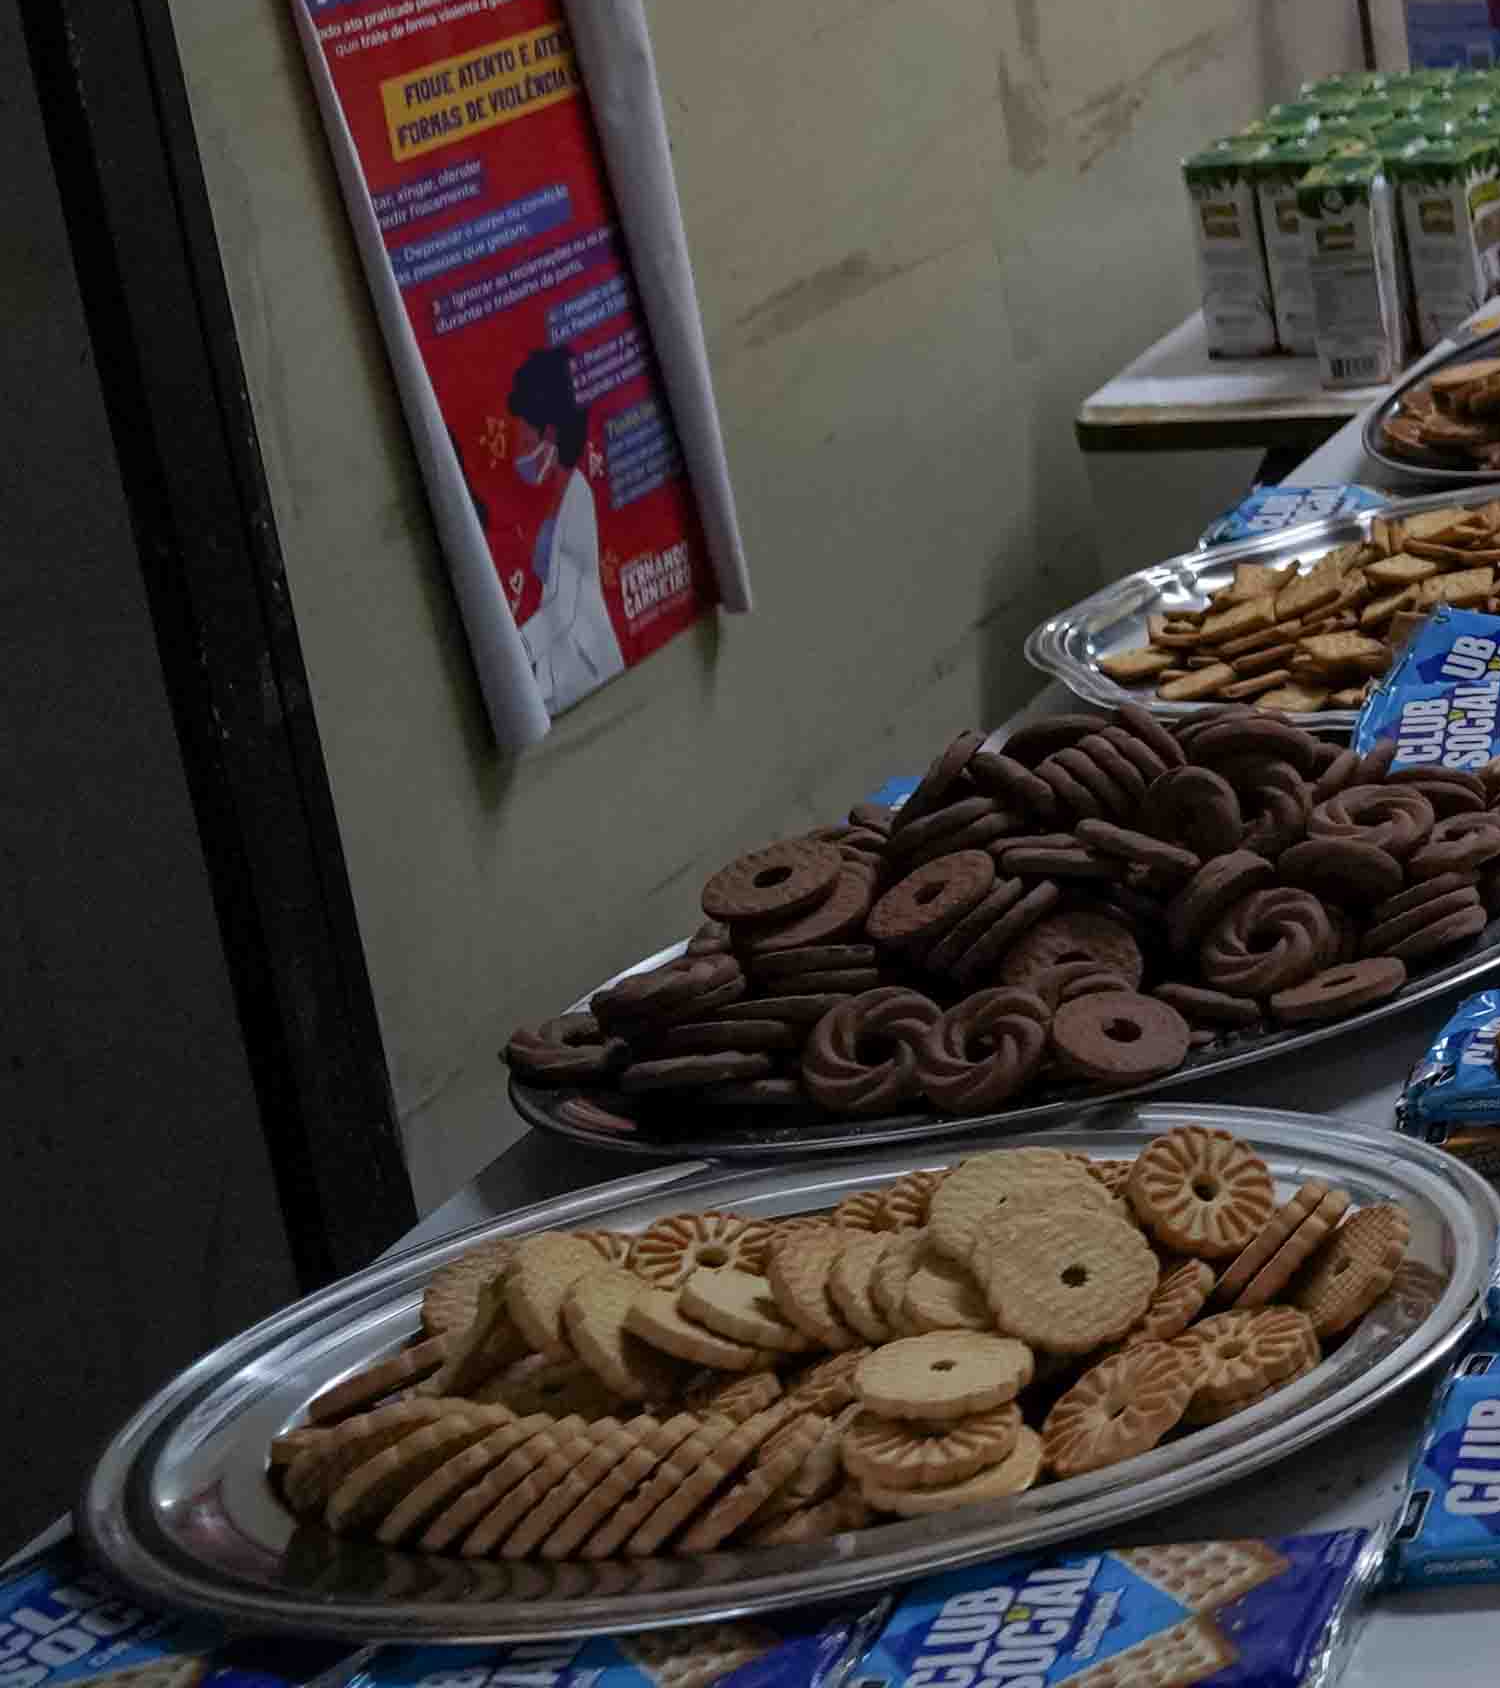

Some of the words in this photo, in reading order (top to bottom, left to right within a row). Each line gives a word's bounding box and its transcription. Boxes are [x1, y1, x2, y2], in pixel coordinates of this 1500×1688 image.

[395, 102, 464, 150] FORMAS
[465, 94, 487, 123] DE
[486, 66, 570, 118] VIOLÊNCIA
[402, 69, 456, 110] FIQUE
[456, 48, 516, 91] ATENTO
[518, 40, 530, 63] E
[1396, 698, 1450, 765] CLUB
[903, 1584, 1018, 1688] CLUB
